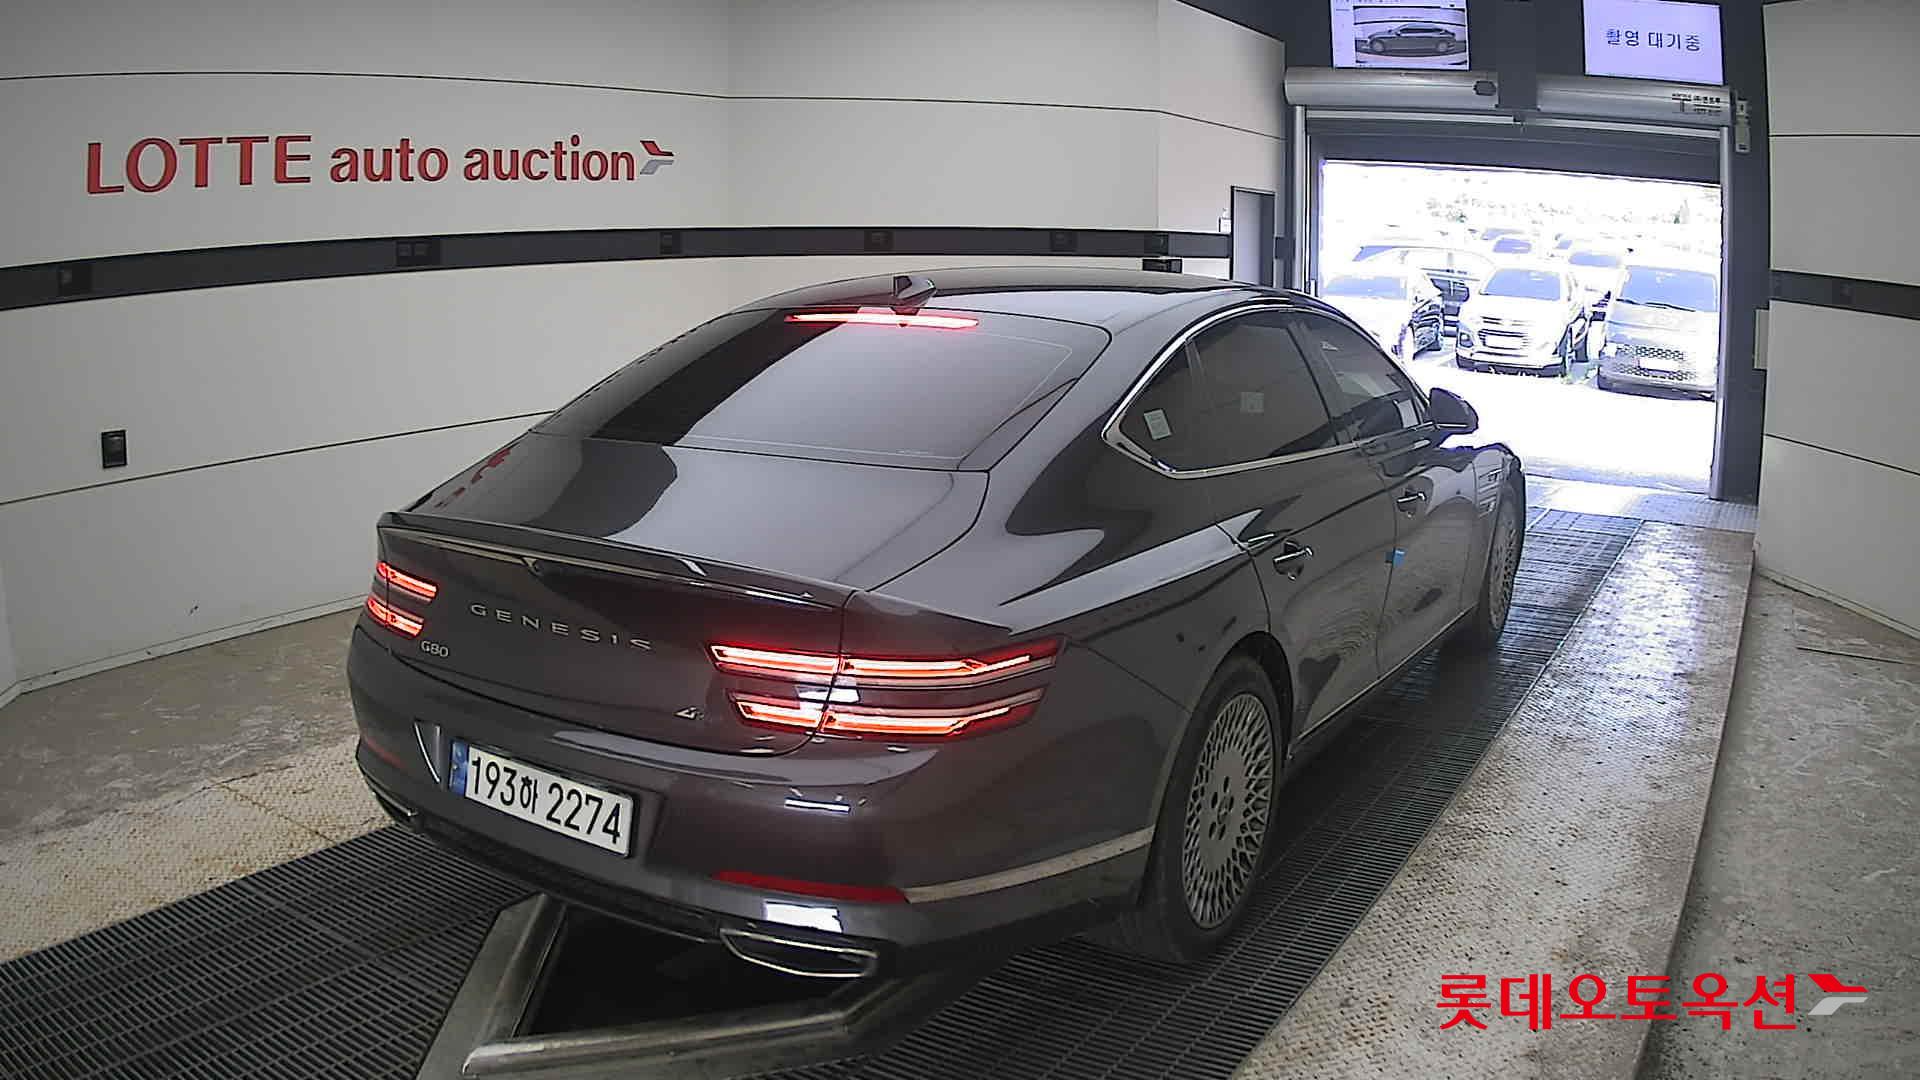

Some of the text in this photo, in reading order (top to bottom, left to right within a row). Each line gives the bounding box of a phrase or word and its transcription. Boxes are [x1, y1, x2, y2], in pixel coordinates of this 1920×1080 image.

[1648, 32, 1701, 52] 대기중
[87, 135, 635, 194] LOTTE auto auction
[420, 640, 450, 657] G80
[470, 603, 652, 650] GENESIS
[472, 756, 621, 844] 193하 2274
